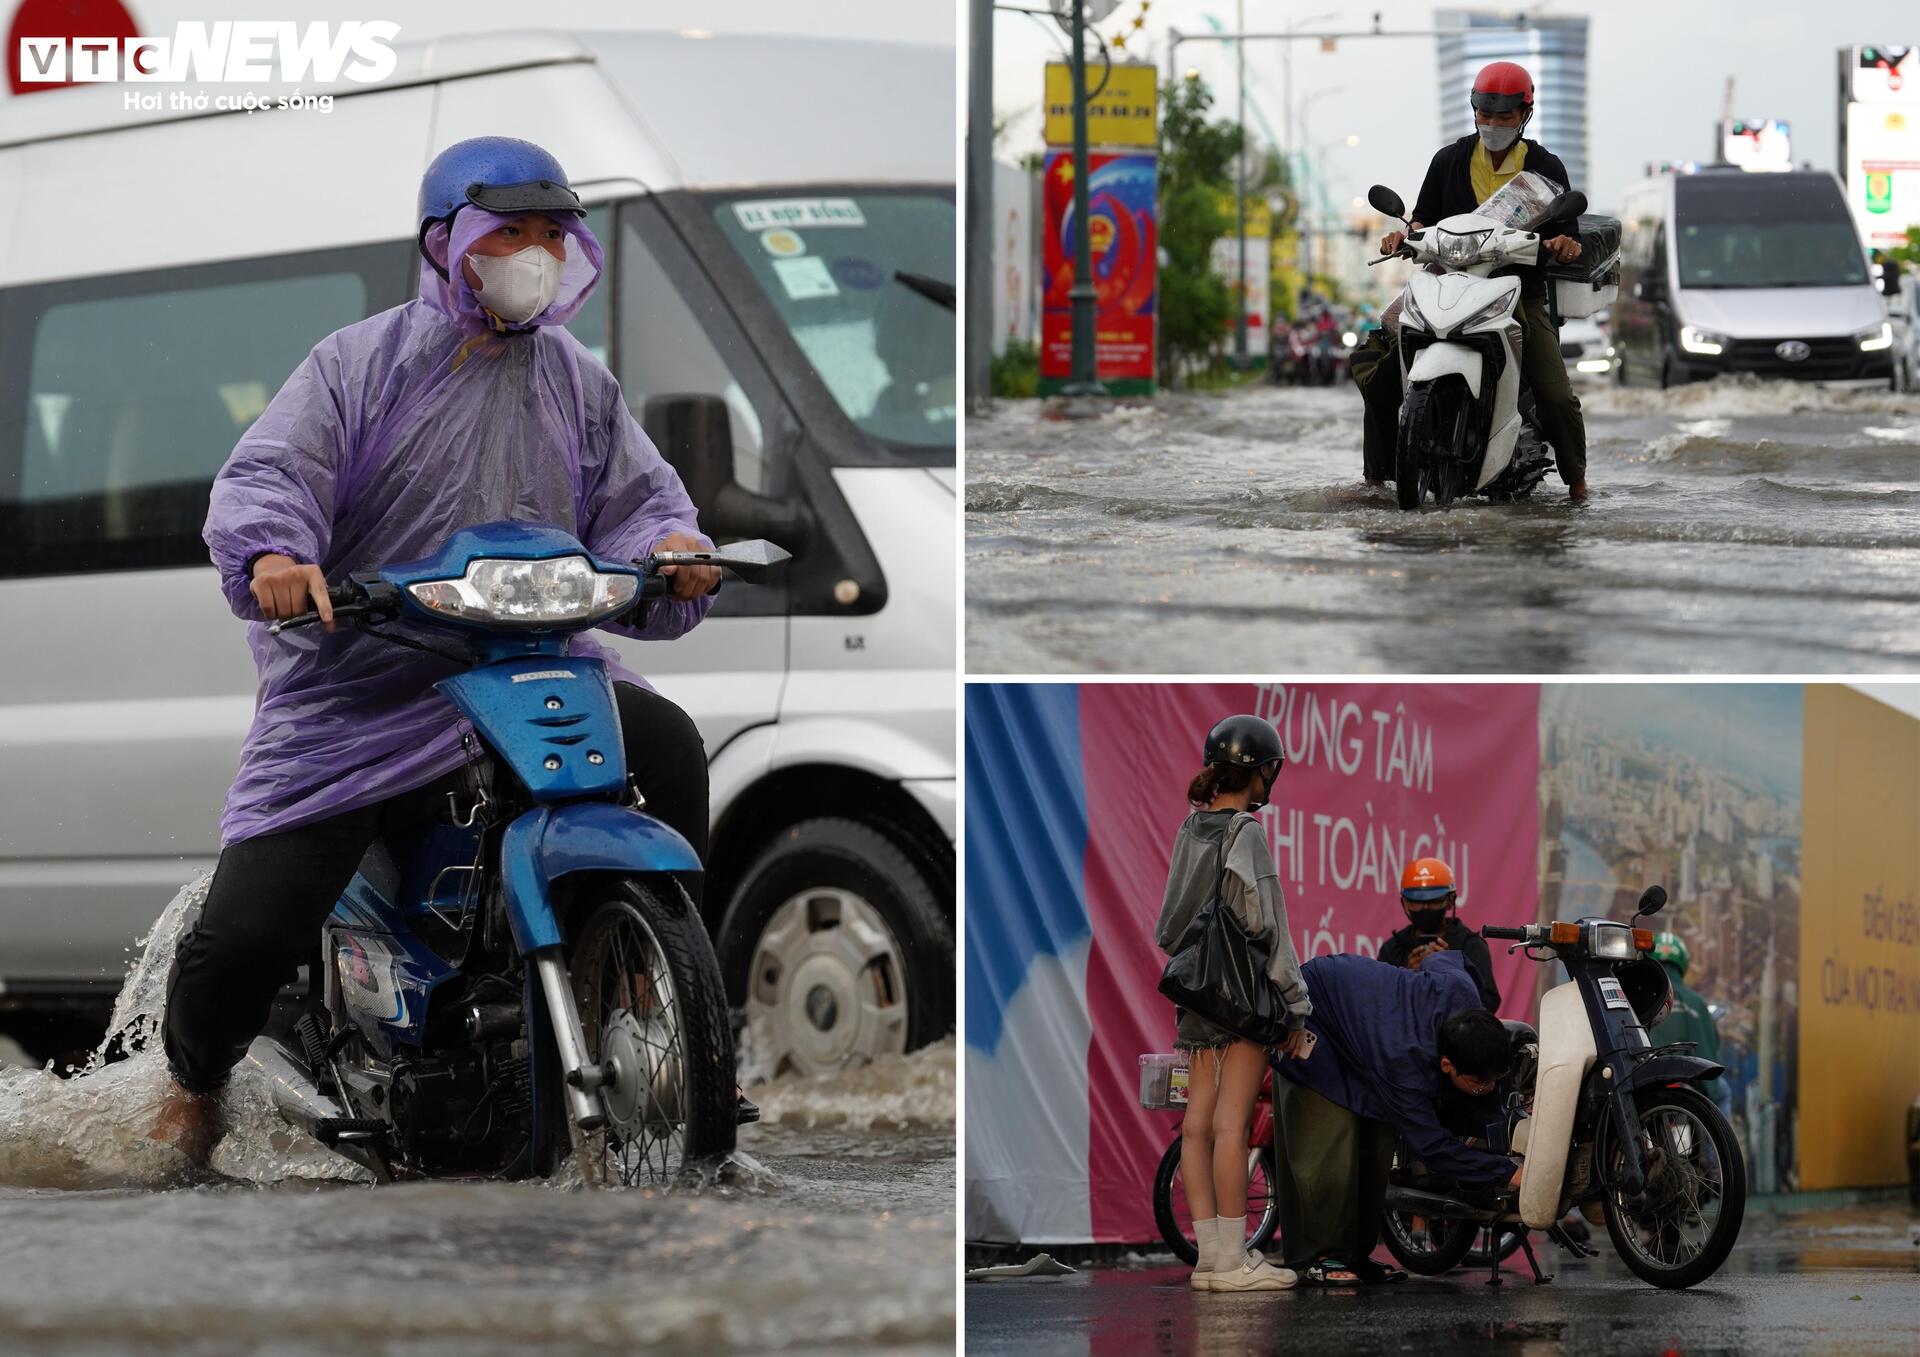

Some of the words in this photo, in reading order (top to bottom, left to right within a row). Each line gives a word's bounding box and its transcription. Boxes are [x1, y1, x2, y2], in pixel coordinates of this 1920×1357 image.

[1254, 683, 1363, 776] TRUNG
[1372, 701, 1434, 794] TÂM
[1314, 801, 1407, 895] TOÀN
